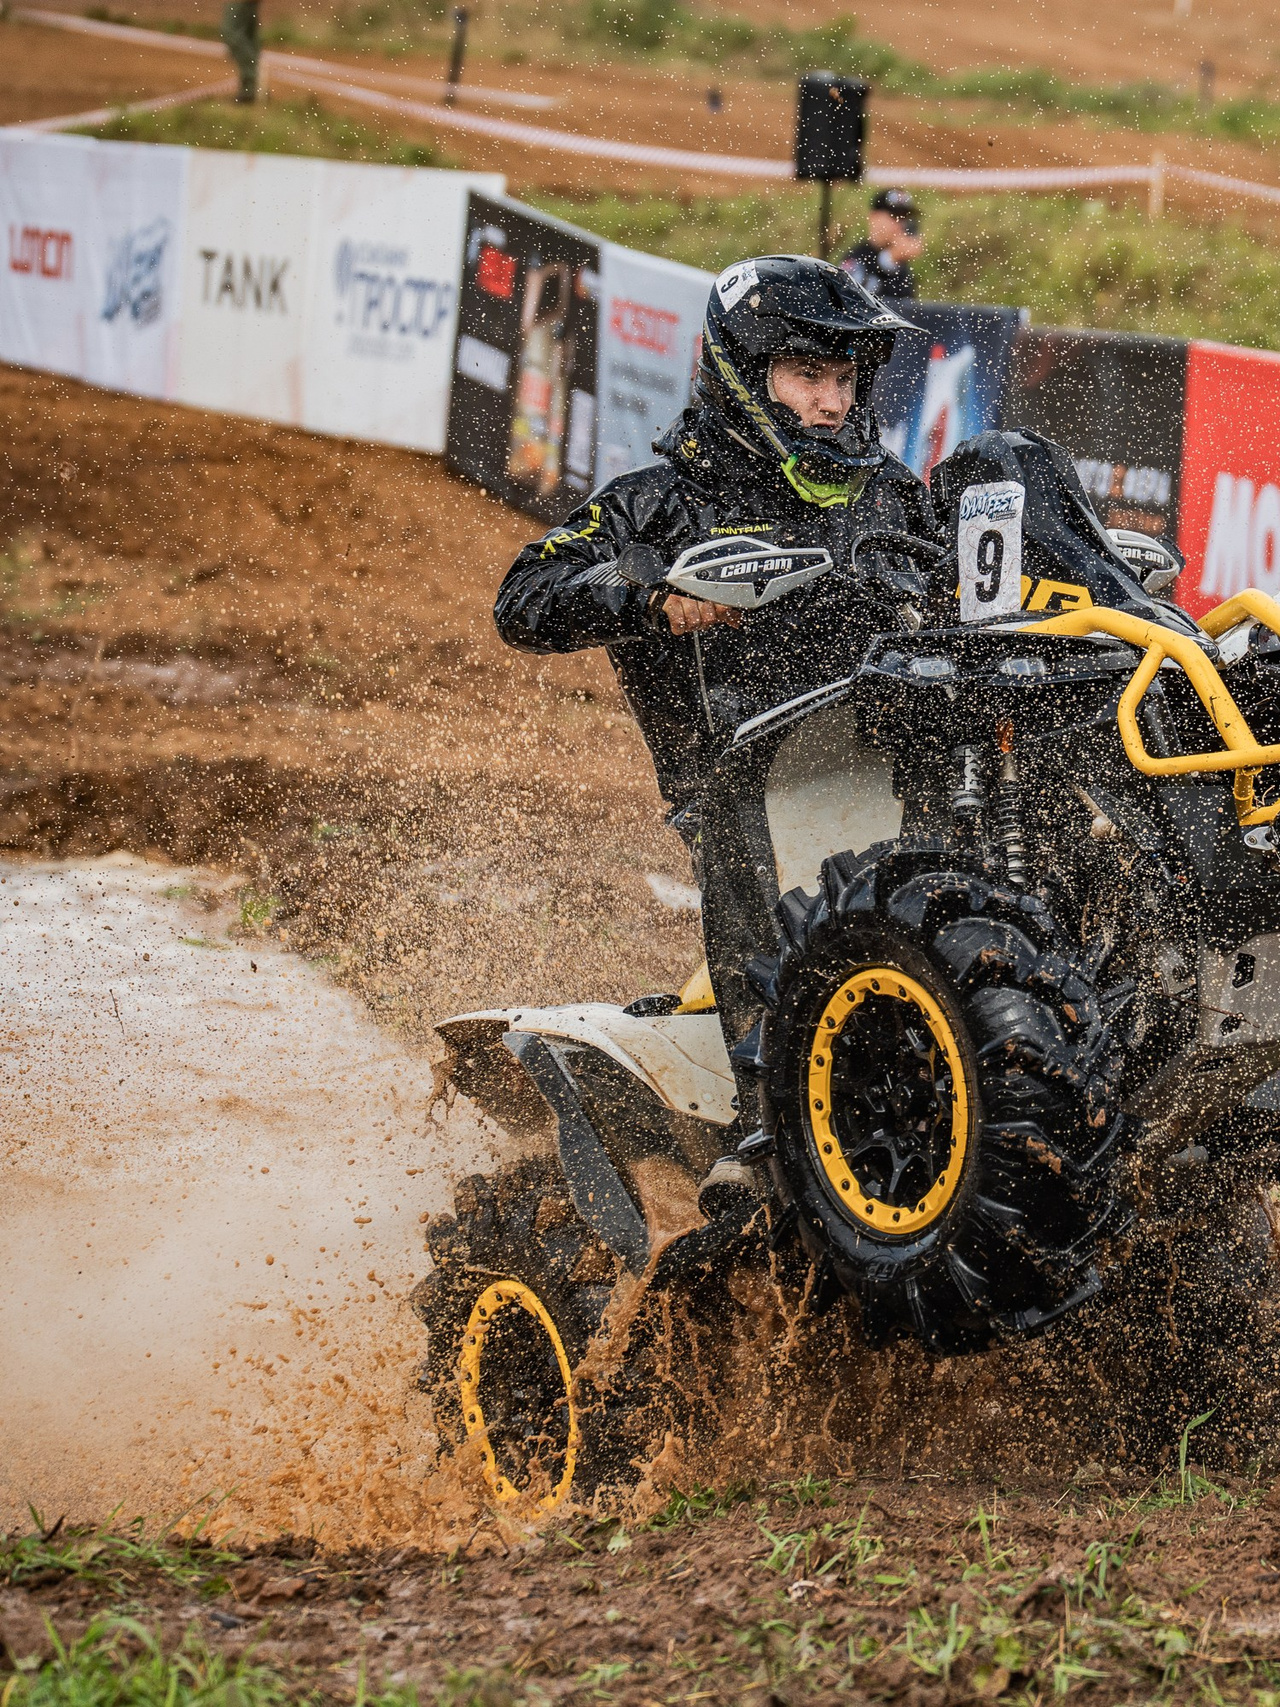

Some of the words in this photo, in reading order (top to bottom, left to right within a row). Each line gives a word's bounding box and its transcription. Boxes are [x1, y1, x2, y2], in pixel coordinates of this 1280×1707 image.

[198, 247, 292, 315] TANK
[720, 275, 739, 293] 9
[709, 344, 778, 432] LEATT
[710, 523, 774, 536] FINNTRAIL
[720, 557, 793, 579] can-am
[974, 528, 1005, 603] 9
